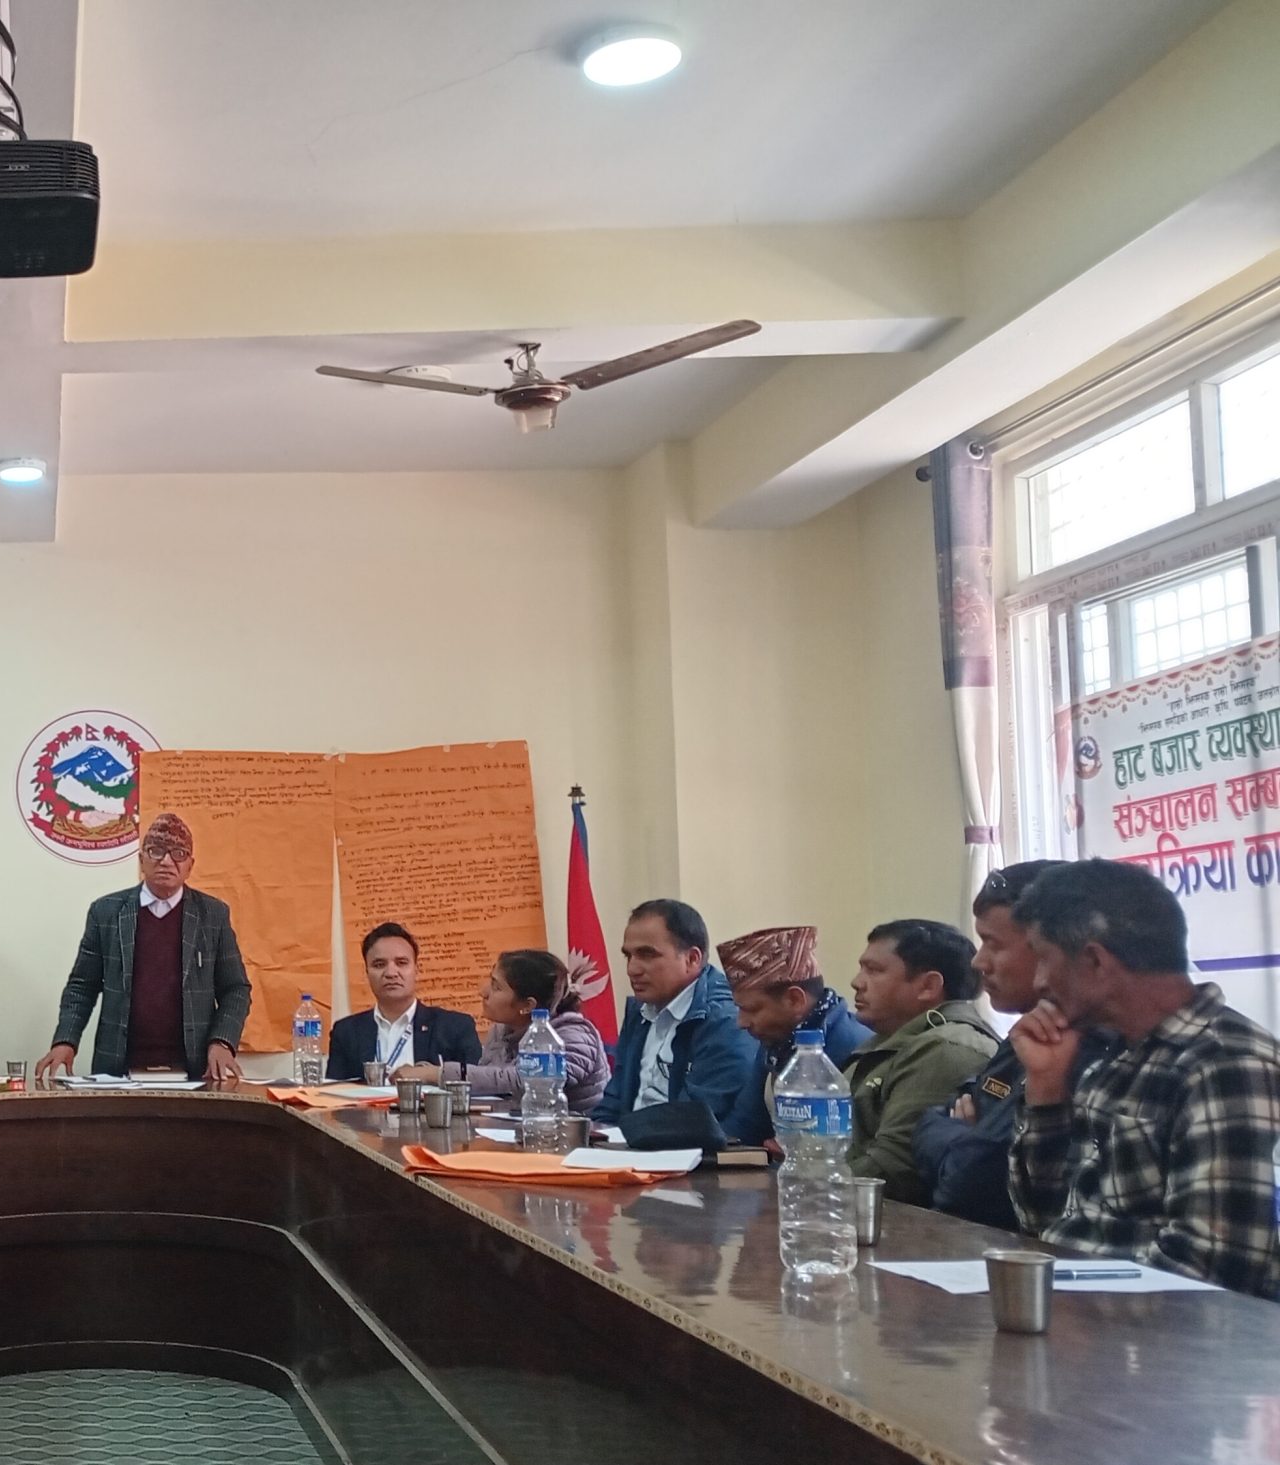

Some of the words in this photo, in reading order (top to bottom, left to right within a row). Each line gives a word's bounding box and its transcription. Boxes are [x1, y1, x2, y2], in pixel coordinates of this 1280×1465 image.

[1113, 744, 1146, 789] हाट
[1150, 729, 1202, 776] बजार
[1225, 767, 1280, 821] सम्ब
